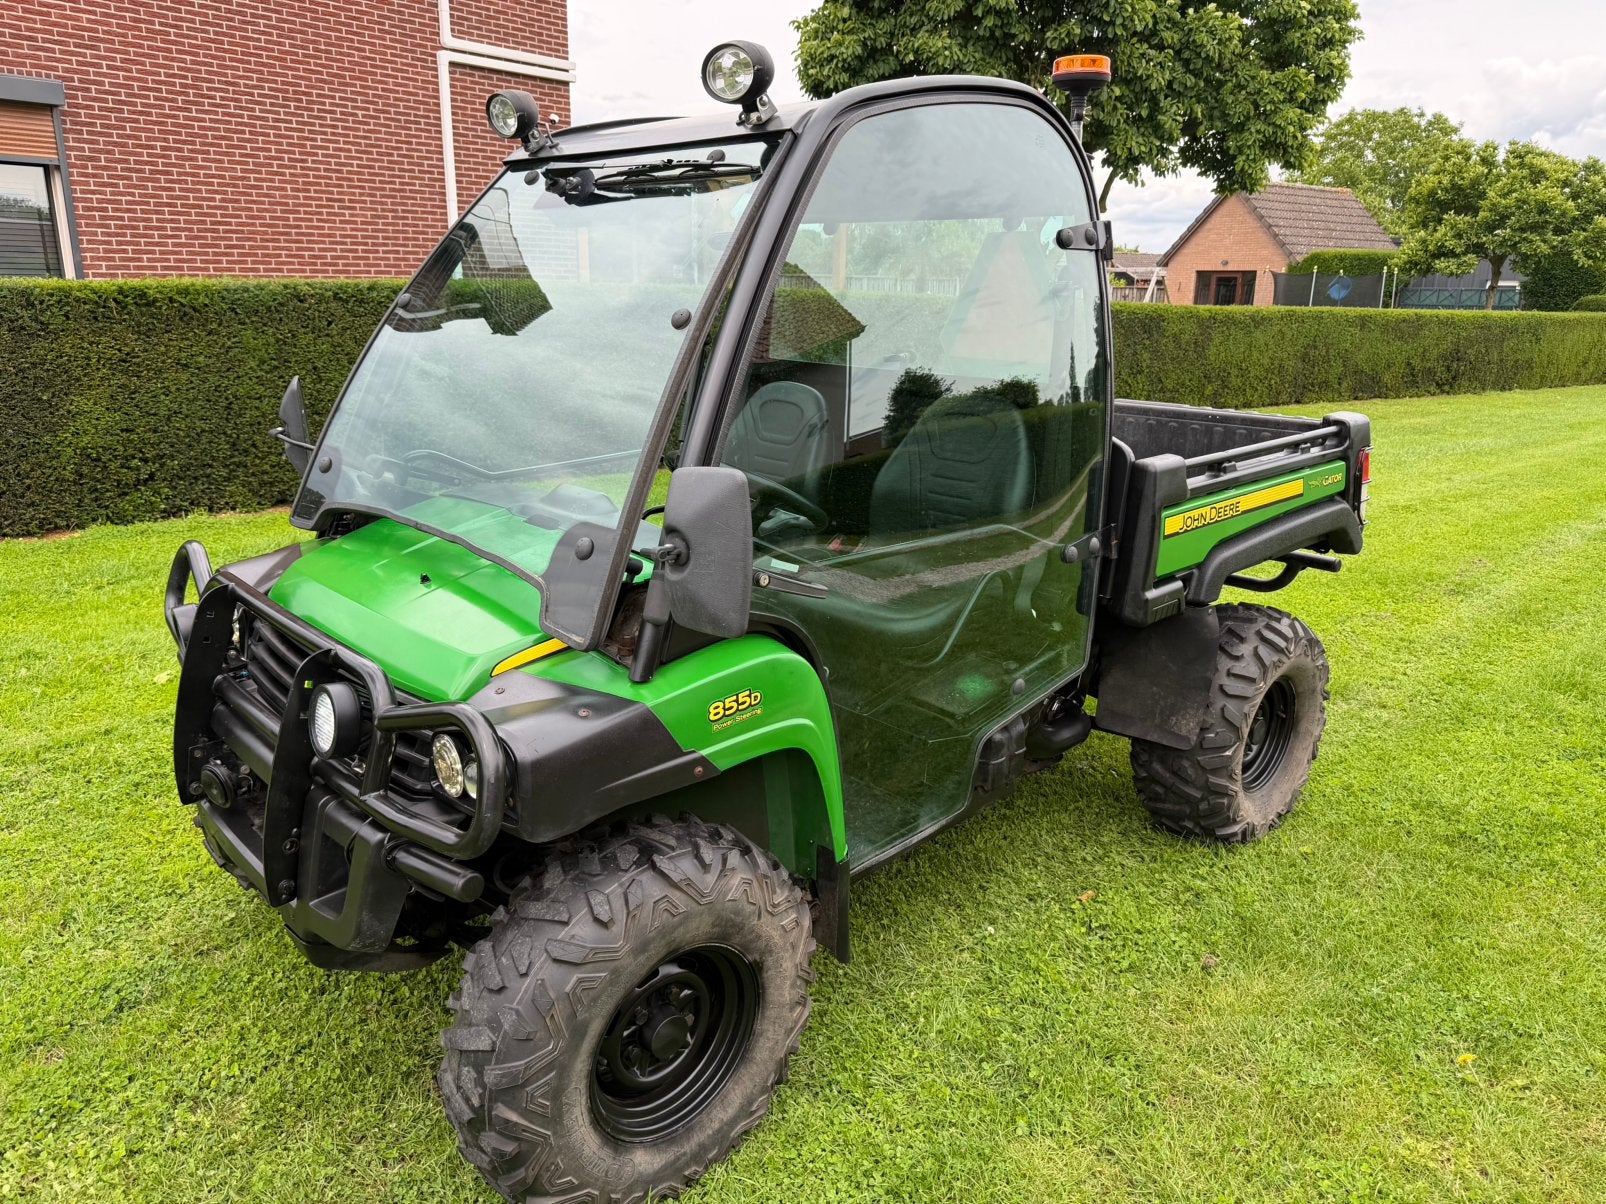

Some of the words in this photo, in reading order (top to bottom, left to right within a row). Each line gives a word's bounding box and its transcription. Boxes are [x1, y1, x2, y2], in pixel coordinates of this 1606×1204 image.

[1179, 511, 1208, 531] JOHN
[1209, 501, 1241, 522] DEERE
[708, 688, 762, 722] 855D
[713, 719, 734, 731] Power
[736, 708, 763, 721] Steering
